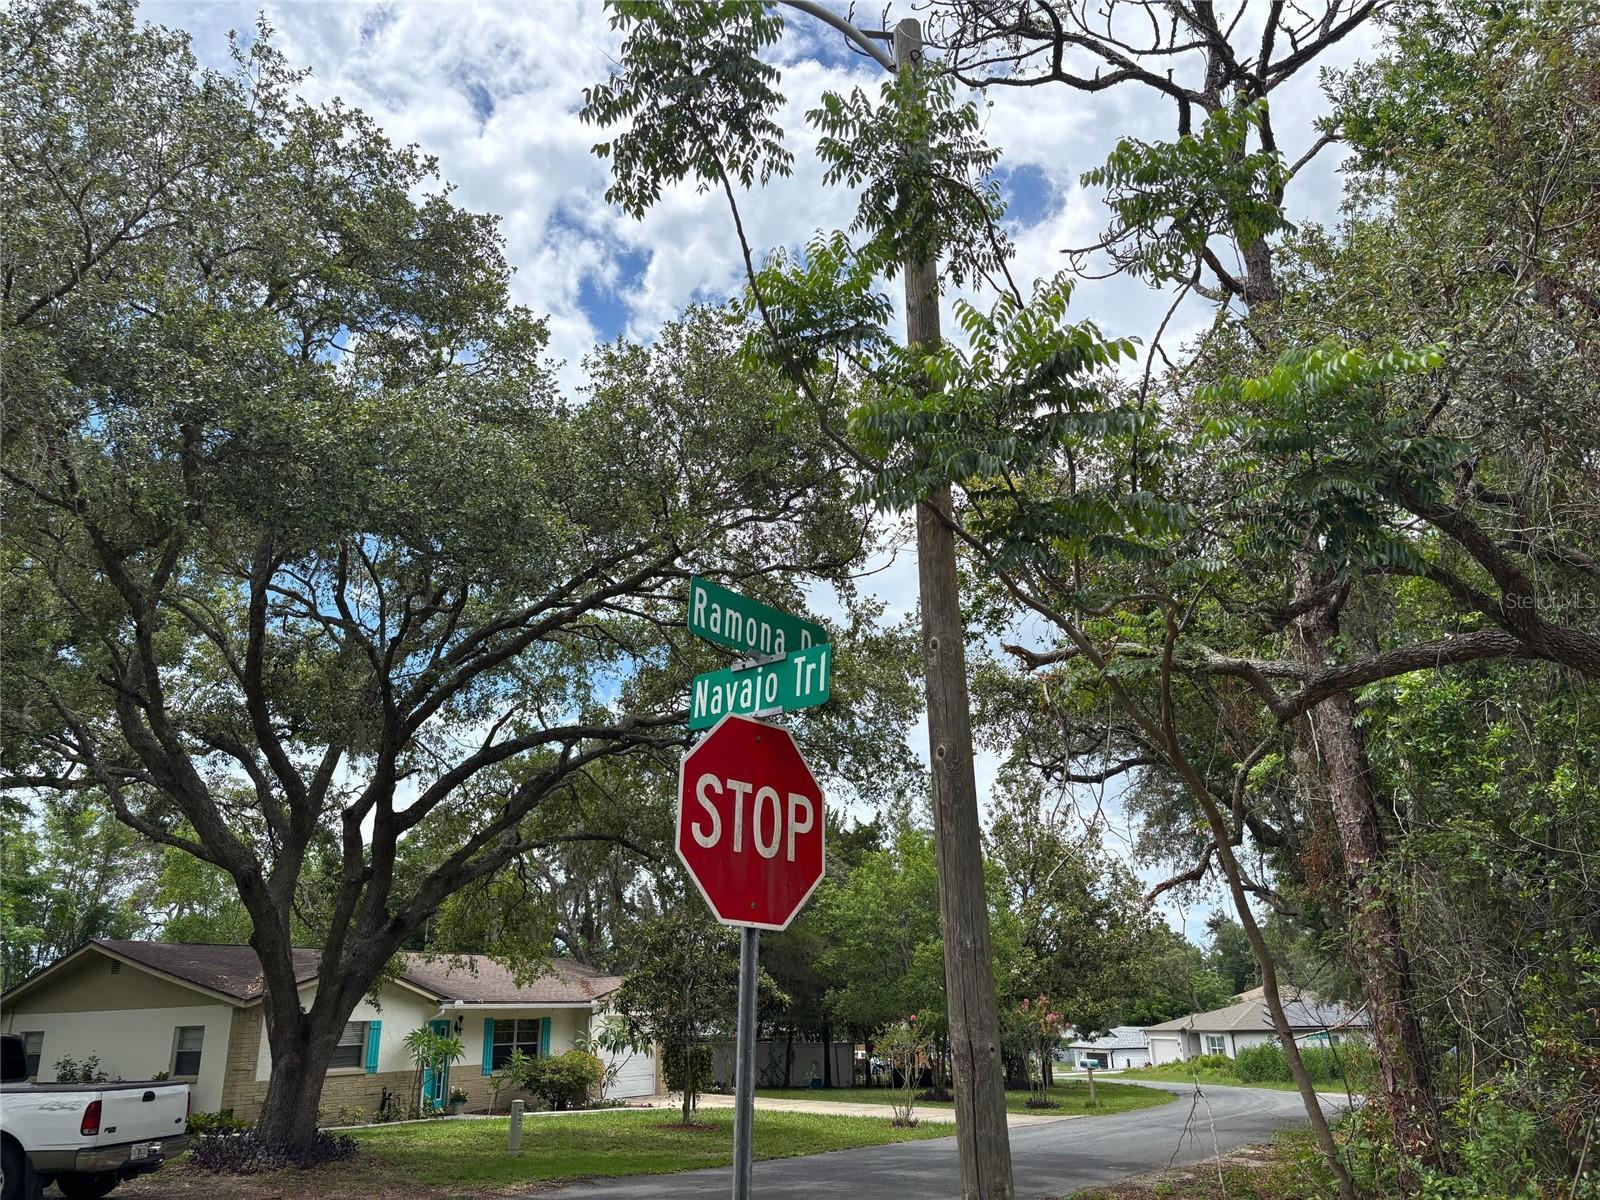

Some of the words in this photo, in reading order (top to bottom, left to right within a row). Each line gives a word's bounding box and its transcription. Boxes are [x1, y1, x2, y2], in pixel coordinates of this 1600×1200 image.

[693, 586, 786, 656] Ramona
[801, 629, 822, 650] D
[693, 666, 778, 718] Navajo
[794, 651, 826, 697] Trl
[691, 773, 814, 862] STOP
